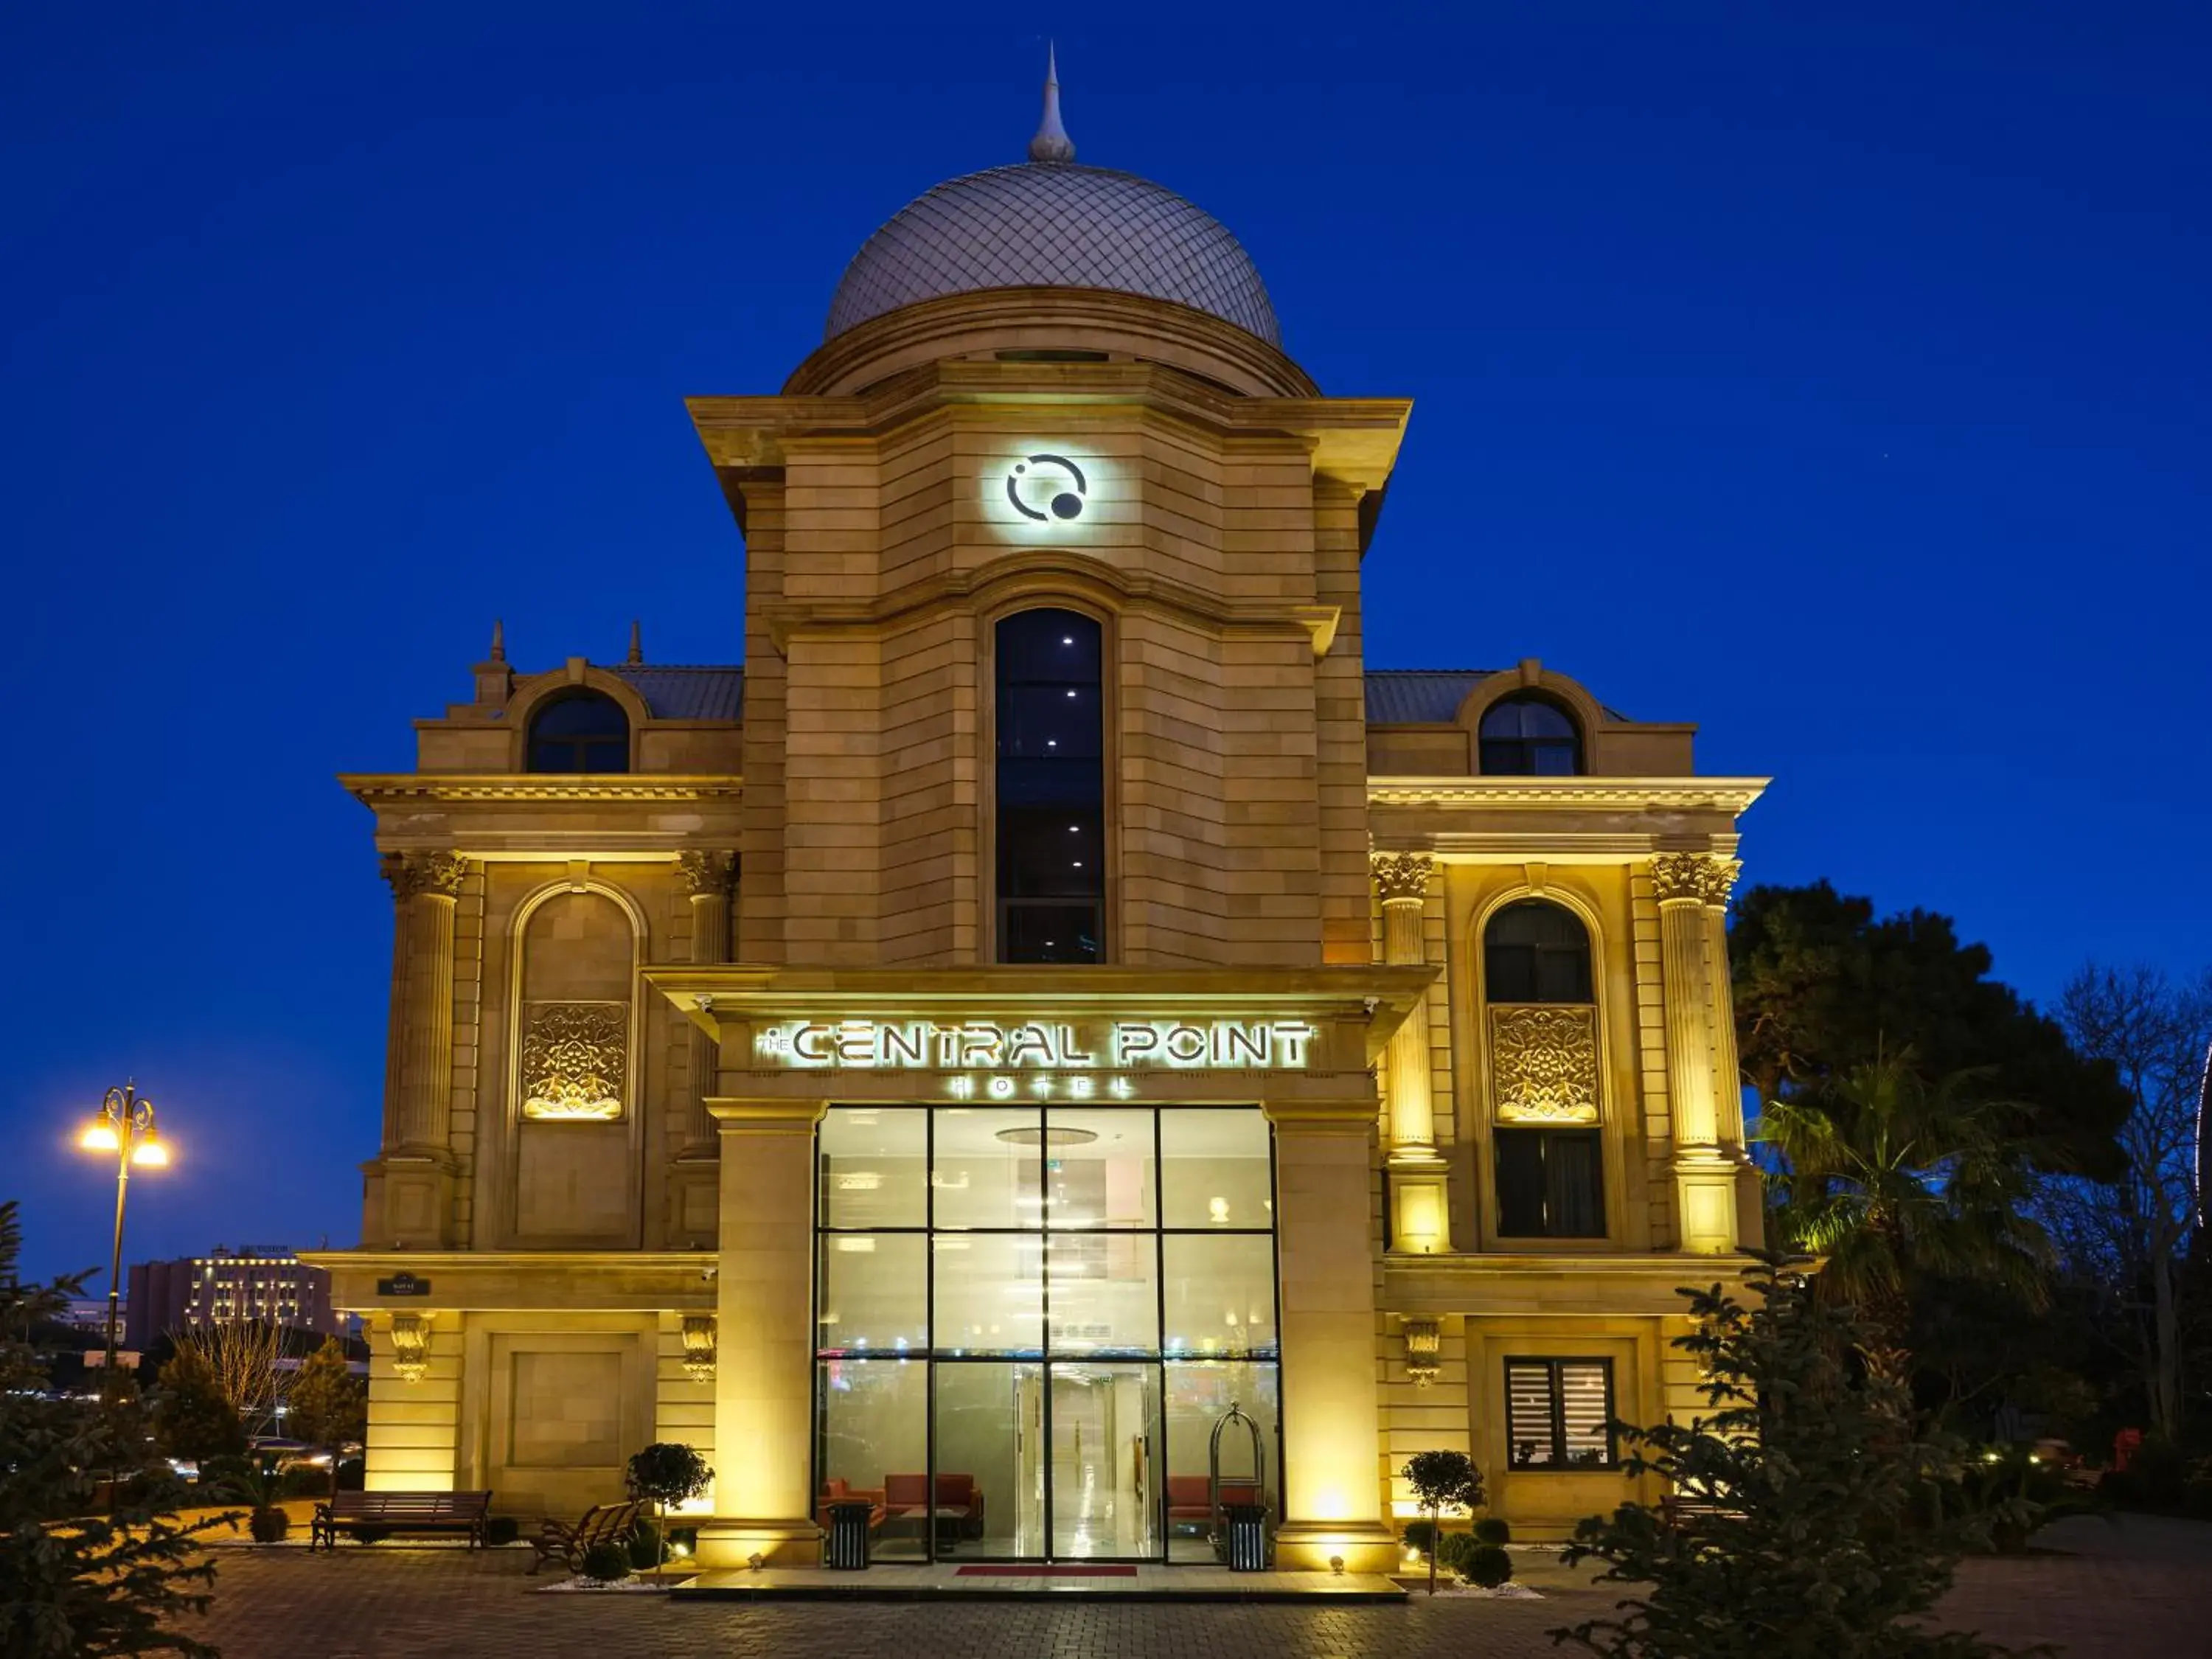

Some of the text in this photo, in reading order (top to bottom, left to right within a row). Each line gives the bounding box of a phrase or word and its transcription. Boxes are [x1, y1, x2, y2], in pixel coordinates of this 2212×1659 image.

[757, 1025, 1310, 1060] THE CENTRAL POINT
[955, 1079, 1130, 1094] HOTEL
